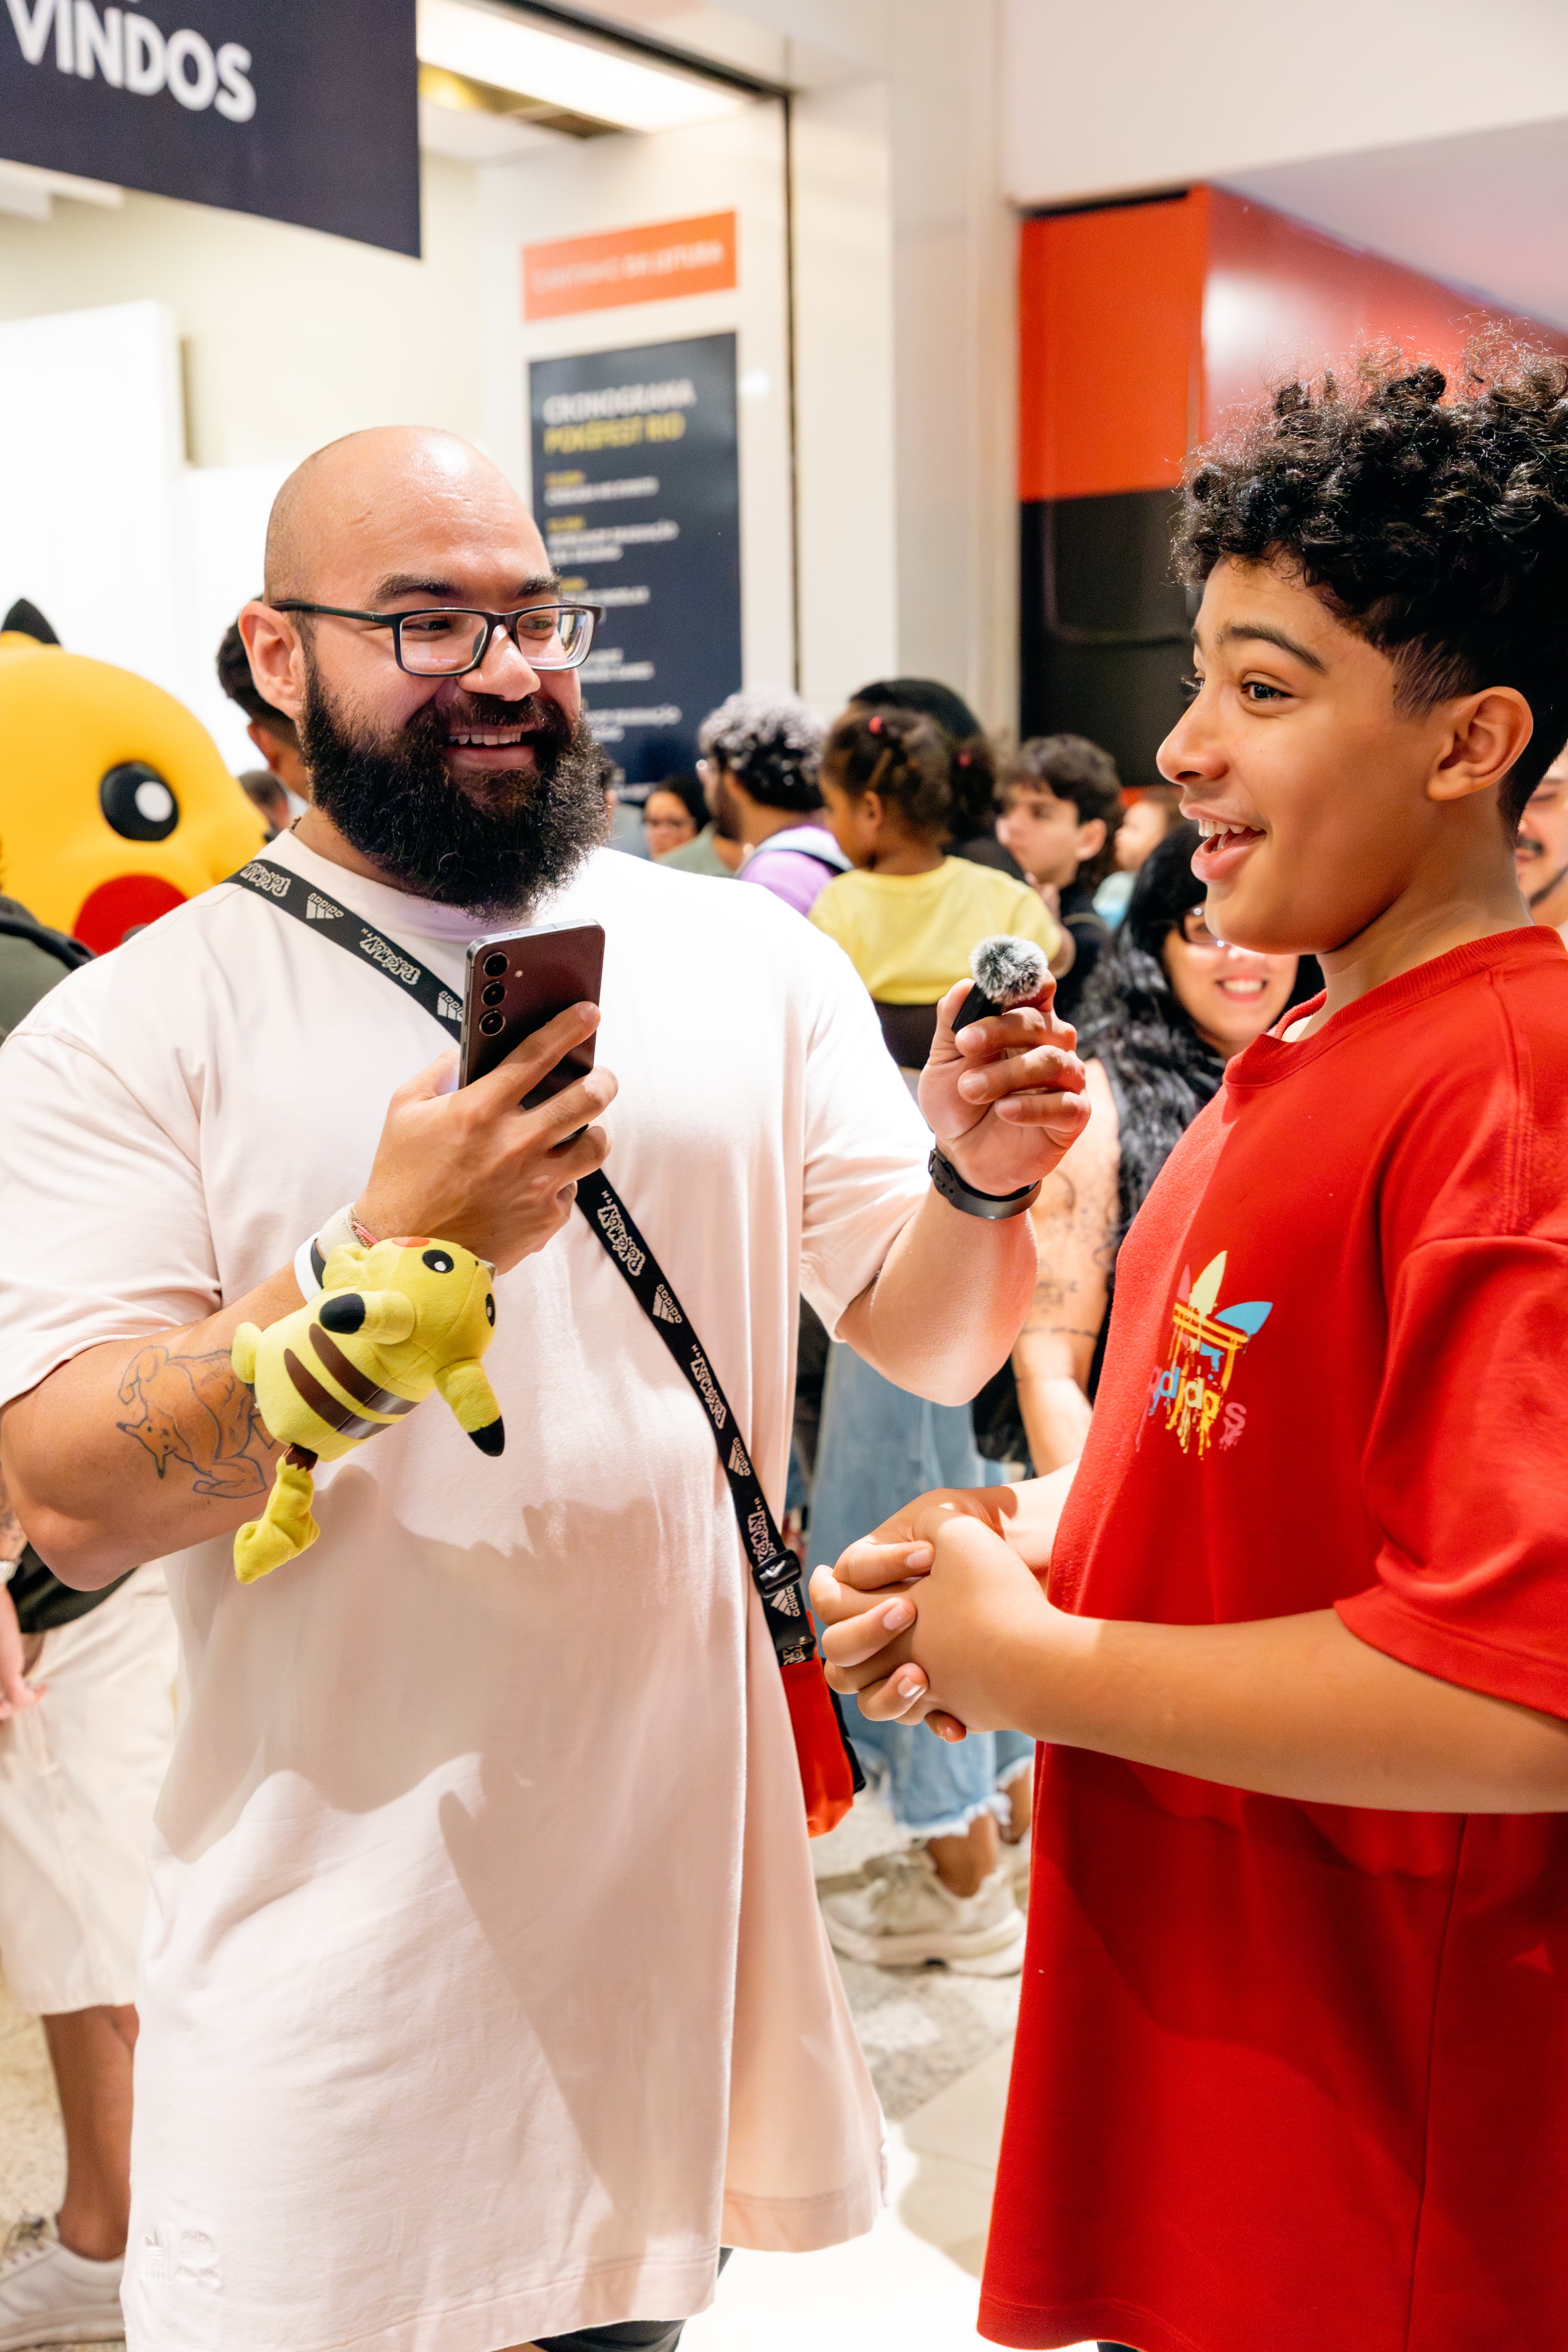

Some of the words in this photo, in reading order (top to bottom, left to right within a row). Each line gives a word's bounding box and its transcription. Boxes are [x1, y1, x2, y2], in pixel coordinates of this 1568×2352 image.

[6, 0, 256, 122] VINDOS
[307, 893, 344, 918] adidas
[439, 991, 463, 1015] idas
[656, 1283, 683, 1324] adidas
[733, 1437, 751, 1477] adidas
[785, 1586, 800, 1617] adida
